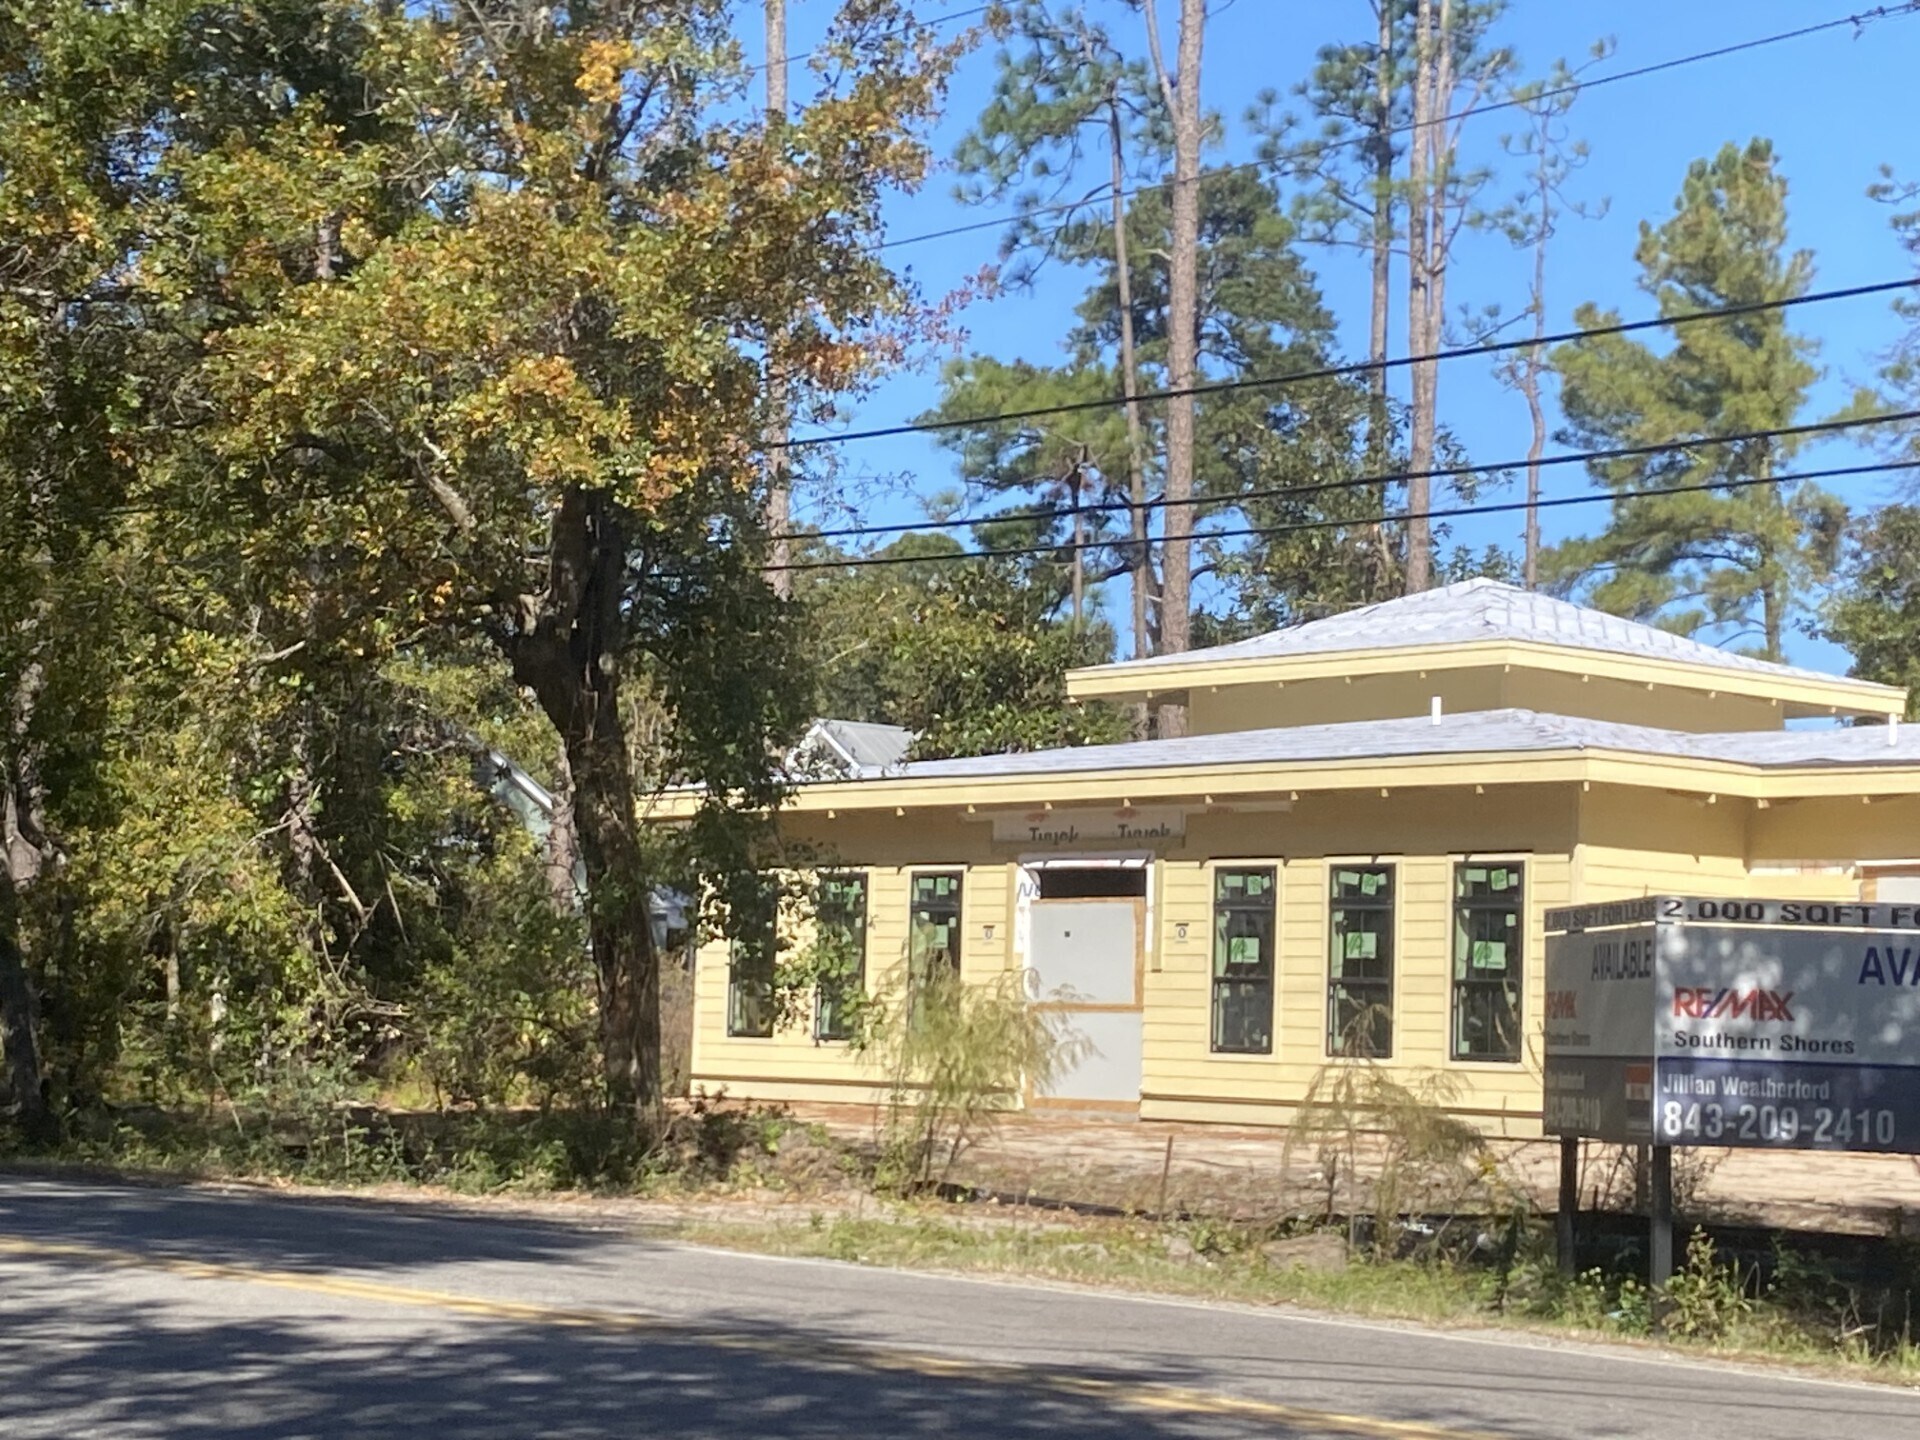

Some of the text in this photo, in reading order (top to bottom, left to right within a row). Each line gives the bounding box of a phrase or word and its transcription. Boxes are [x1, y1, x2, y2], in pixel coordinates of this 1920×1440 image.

[1663, 899, 1765, 921] 2,000
[1780, 903, 1876, 925] SQFT
[1591, 940, 1652, 981] AVAILABLE
[1673, 986, 1795, 1021] RE/MAX
[1674, 1030, 1856, 1055] Southern Shores
[1663, 1073, 1716, 1095] Jillian
[1721, 1075, 1830, 1100] Weatherford
[1663, 1100, 1896, 1145] 843-209-2410
